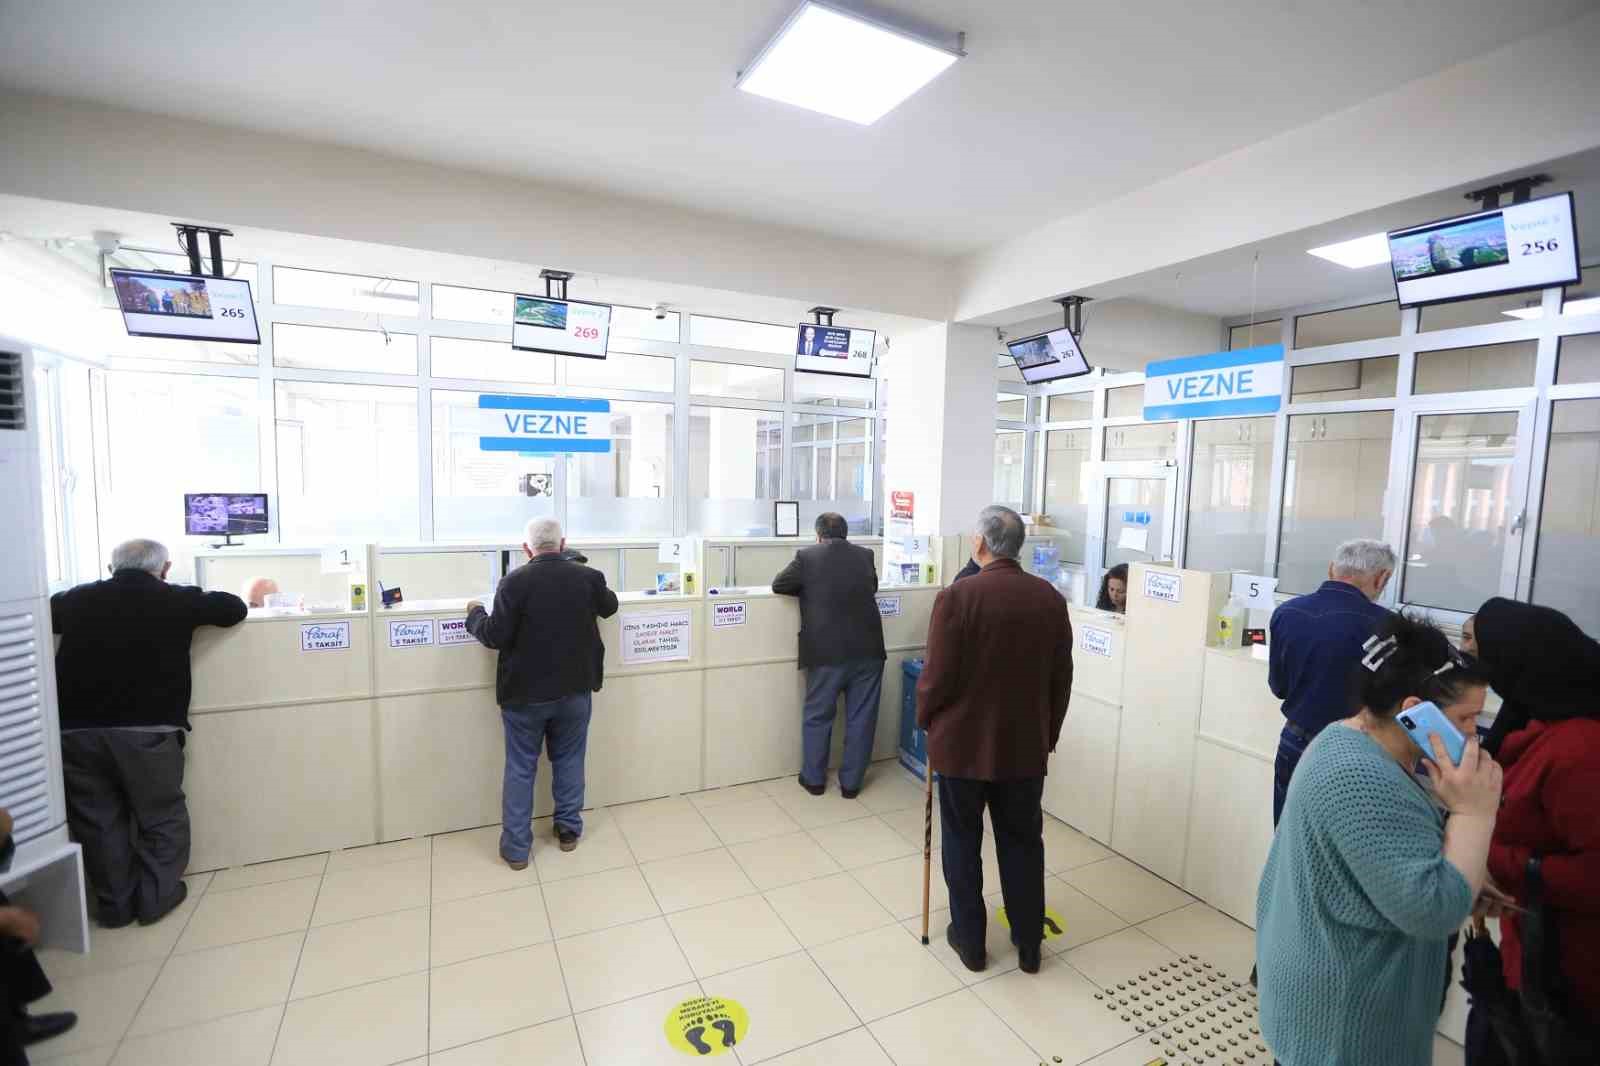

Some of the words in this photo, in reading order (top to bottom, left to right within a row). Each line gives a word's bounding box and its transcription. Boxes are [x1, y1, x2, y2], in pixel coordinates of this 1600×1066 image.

[1521, 238, 1559, 256] 256
[220, 307, 245, 318] 265
[574, 326, 599, 339] 269
[1167, 370, 1253, 400] VEZNE
[505, 413, 587, 434] VEZNE
[672, 543, 680, 556] 2
[912, 539, 919, 550] 3
[340, 549, 351, 565] 1
[1249, 582, 1260, 598] 5
[717, 605, 743, 613] WORLD
[442, 622, 465, 630] WOR
